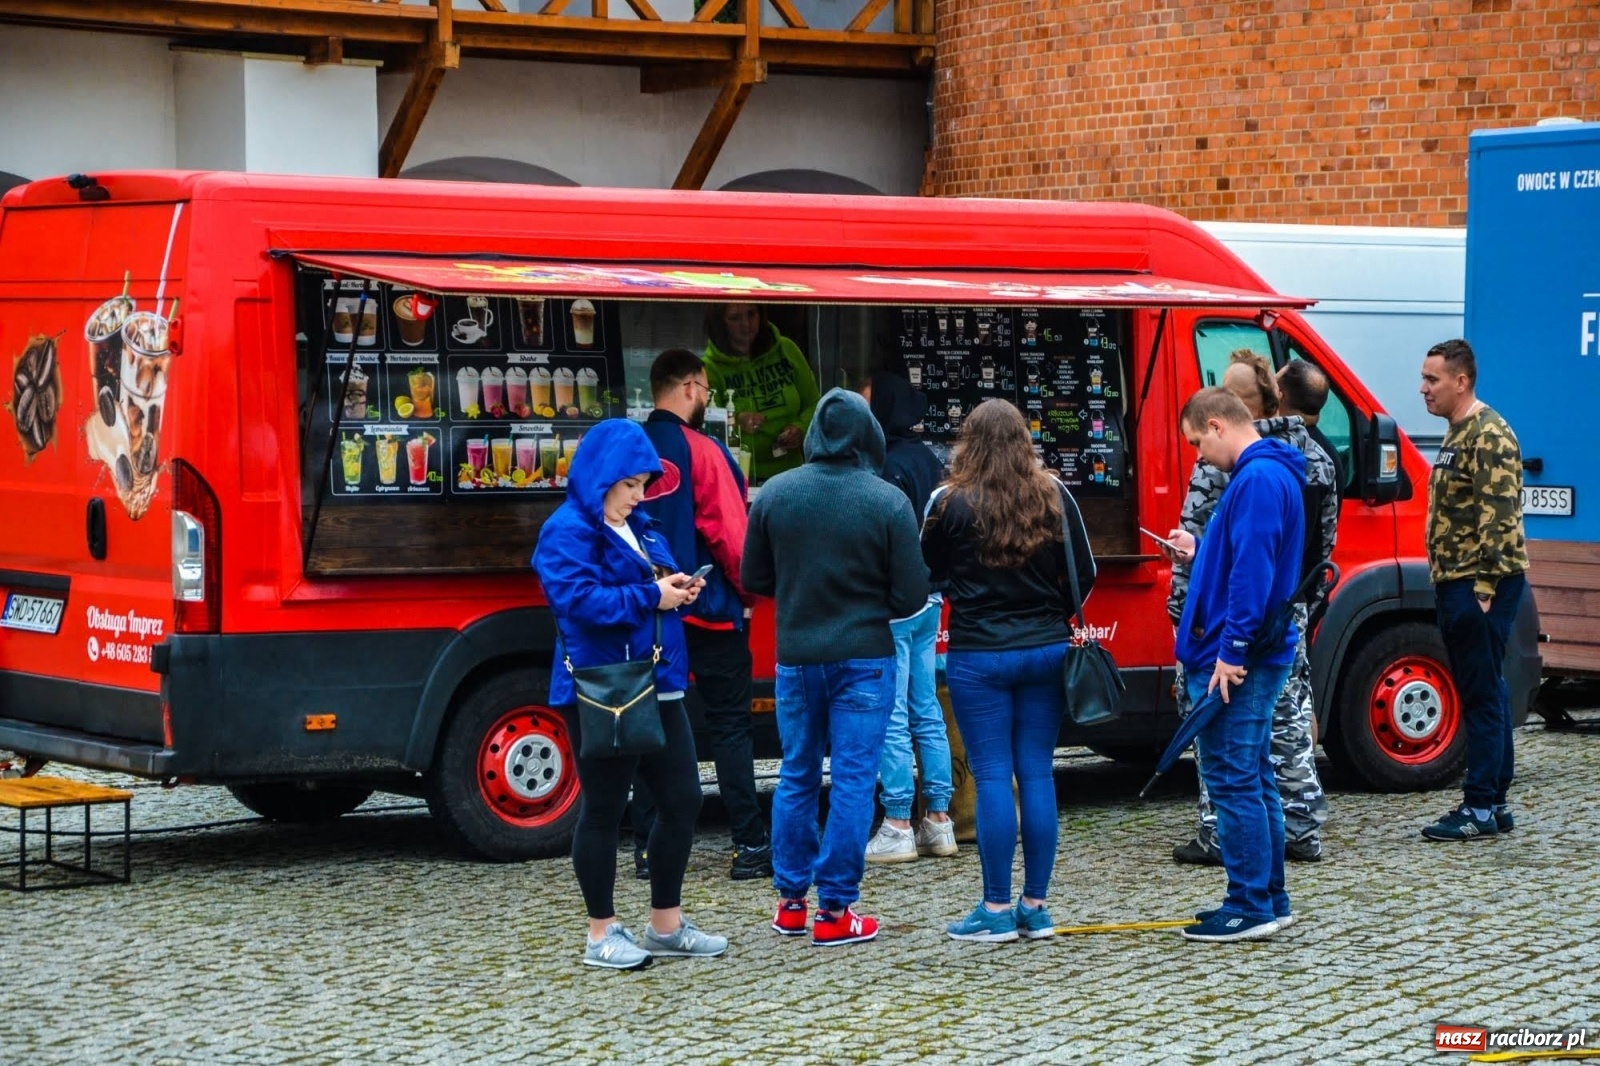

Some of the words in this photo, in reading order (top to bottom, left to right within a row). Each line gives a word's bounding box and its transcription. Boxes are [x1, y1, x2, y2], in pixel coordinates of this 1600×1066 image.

[1517, 172, 1556, 192] OWOCE
[1559, 171, 1570, 190] W
[1532, 489, 1568, 508] 85SS
[128, 609, 164, 640] Imprez
[1071, 620, 1117, 641] eebar/
[100, 642, 116, 660] +48
[116, 645, 131, 662] 605
[132, 646, 148, 664] 283
[1460, 822, 1480, 838] N
[850, 918, 862, 935] N
[600, 945, 616, 960] N
[678, 937, 696, 950] N
